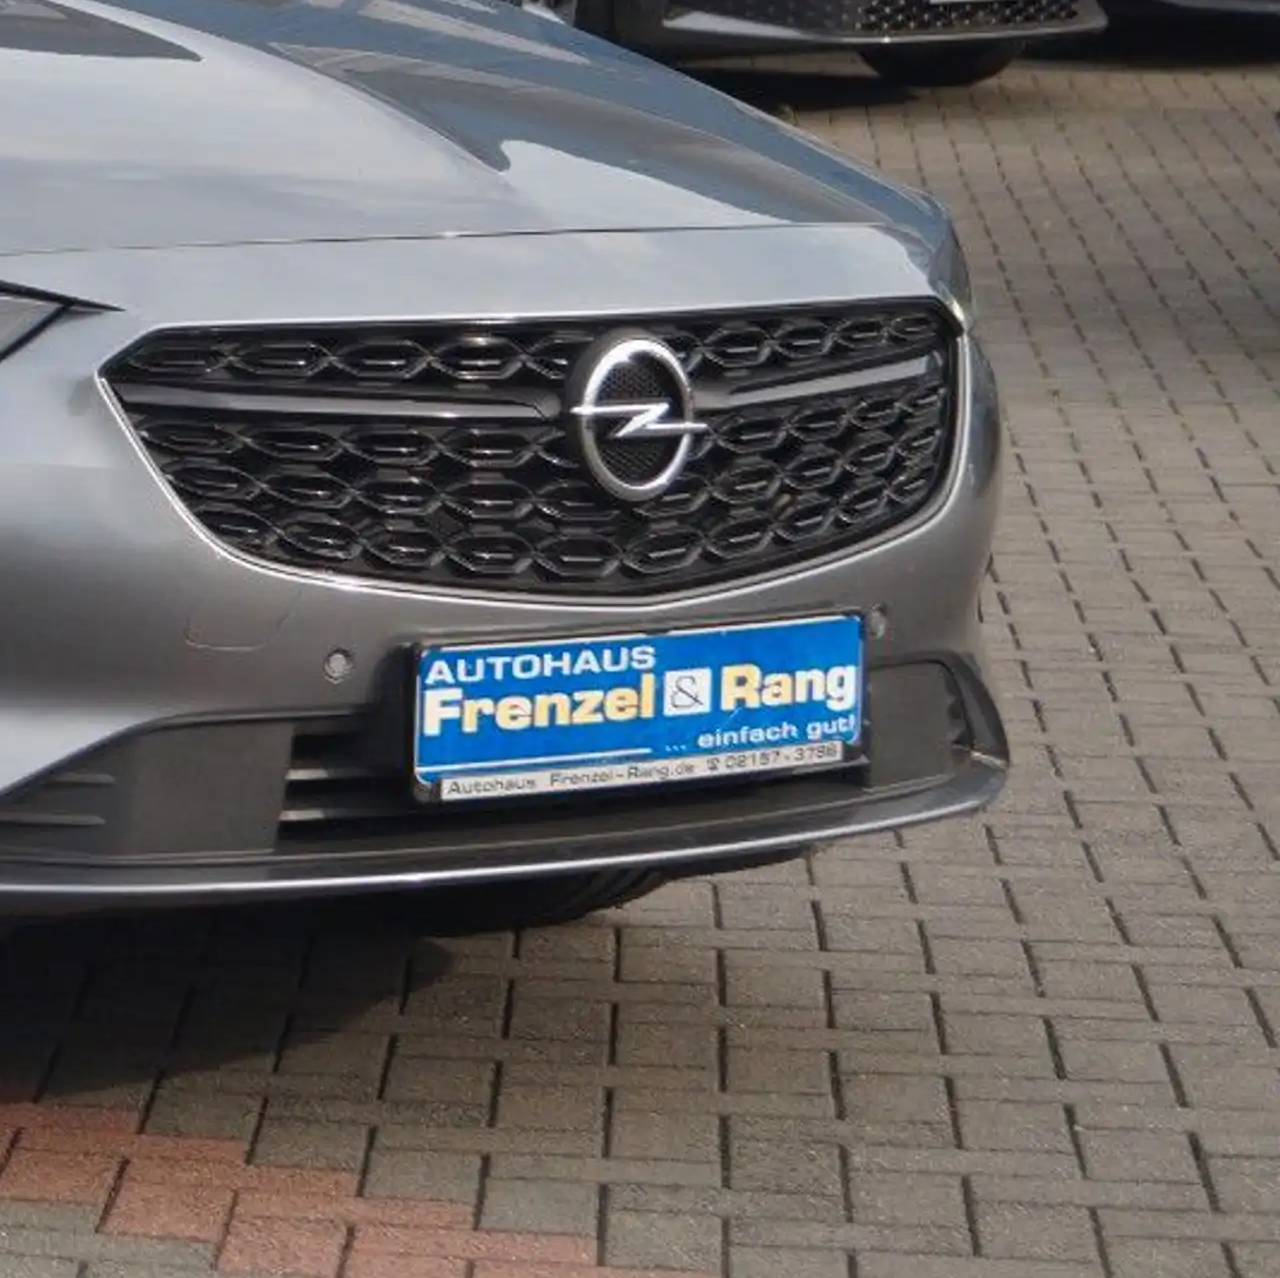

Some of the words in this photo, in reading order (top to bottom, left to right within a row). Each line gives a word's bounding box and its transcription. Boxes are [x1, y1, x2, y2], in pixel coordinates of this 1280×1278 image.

[425, 646, 656, 684] AUTOHAUS
[423, 673, 655, 737] Frenzel
[721, 663, 856, 711] Rang
[697, 721, 798, 749] einfach
[448, 777, 536, 795] Autohaus
